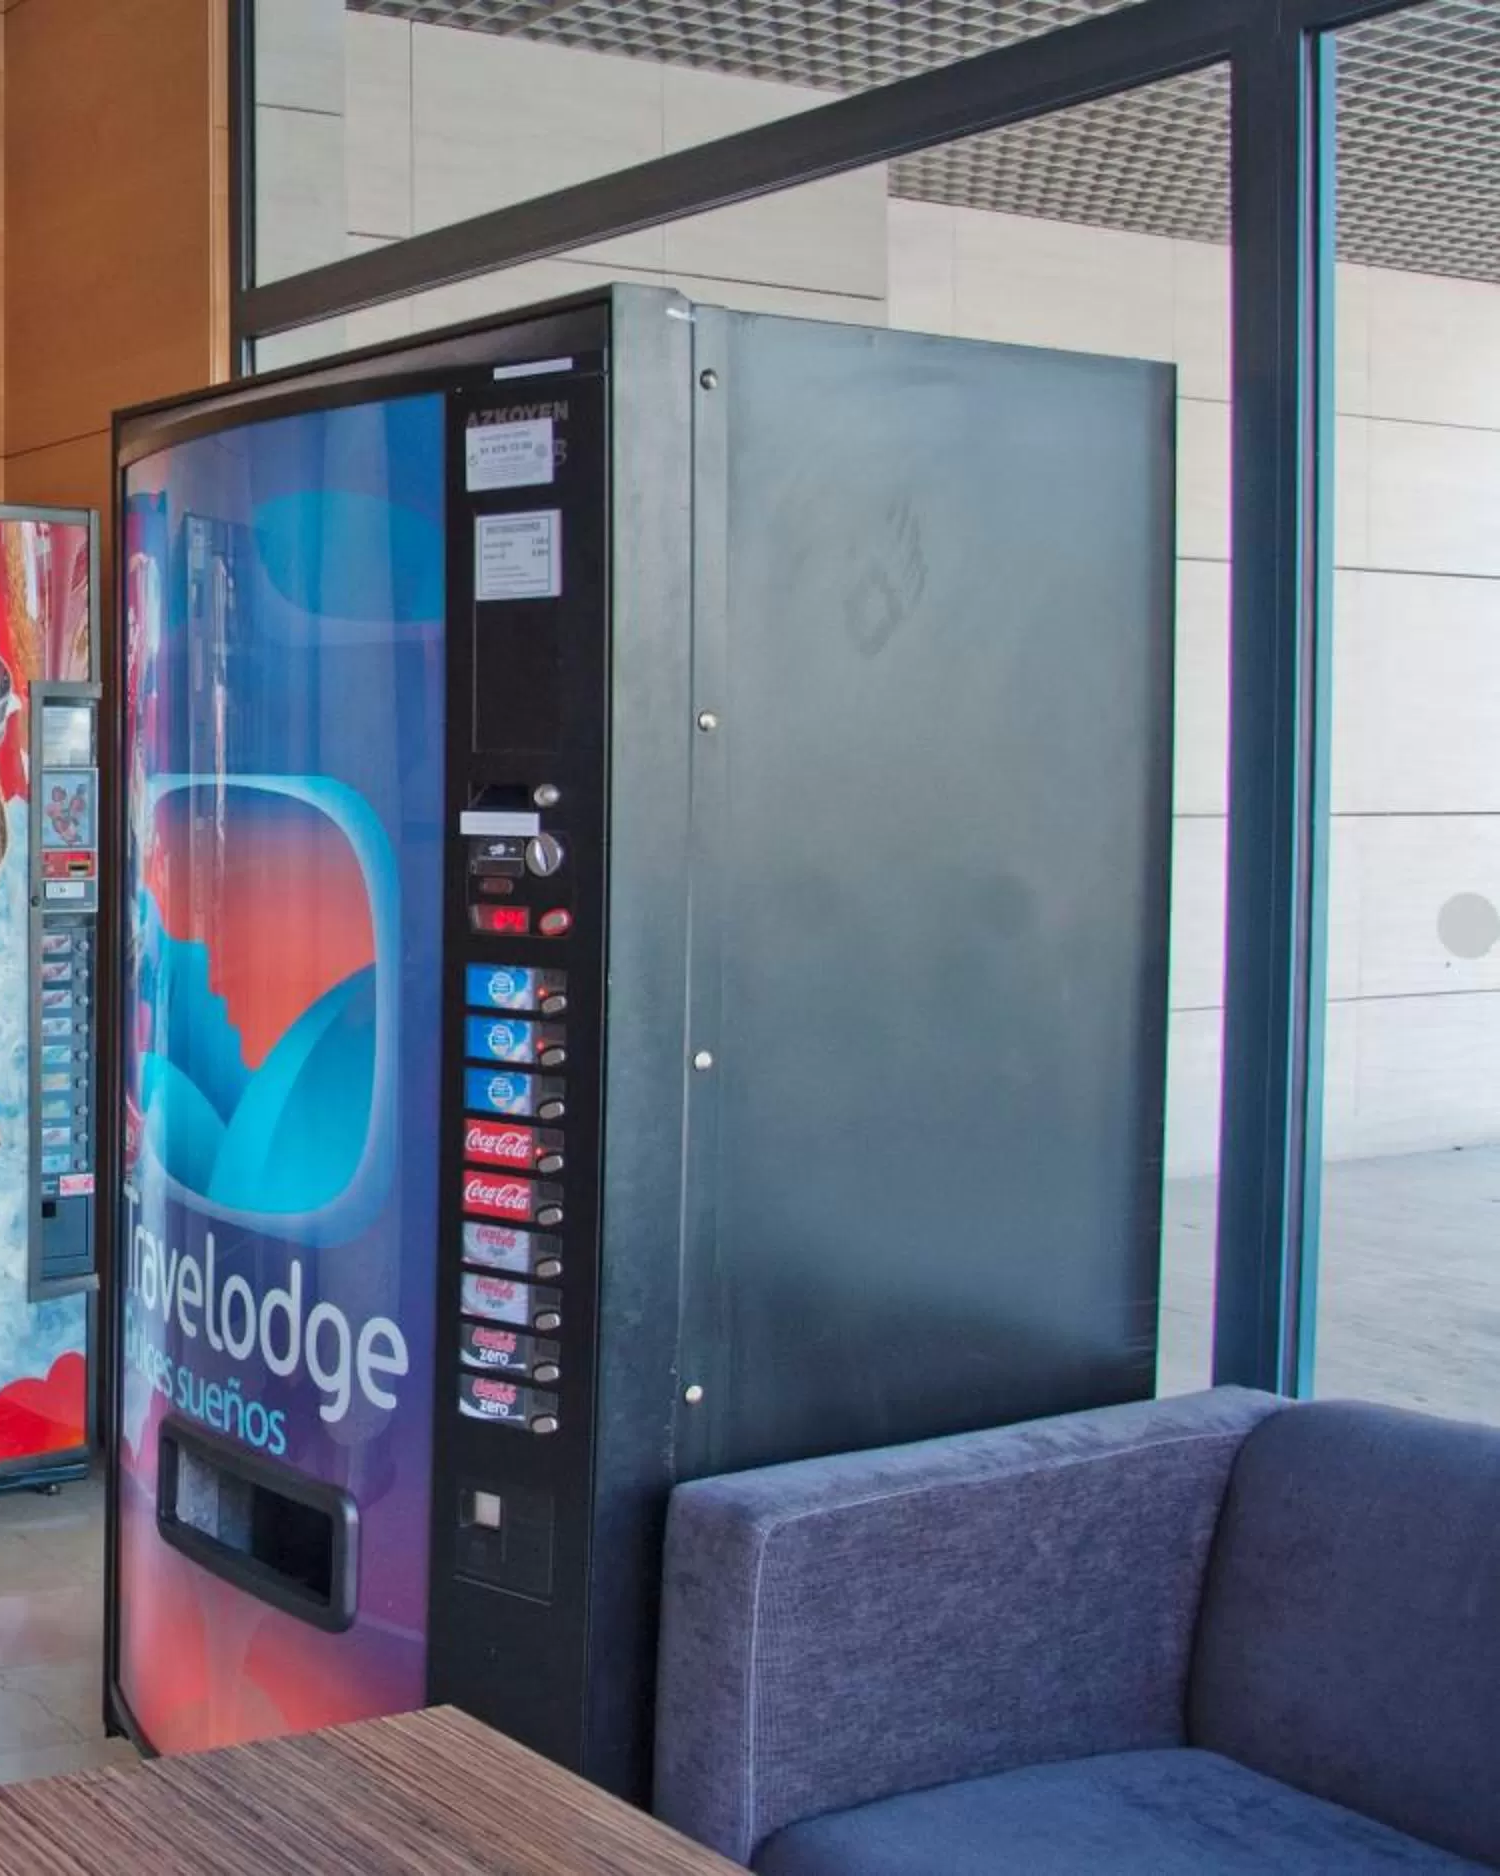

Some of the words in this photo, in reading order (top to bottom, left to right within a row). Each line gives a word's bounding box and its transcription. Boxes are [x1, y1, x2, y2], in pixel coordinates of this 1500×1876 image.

[467, 400, 569, 427] AZKOYEN
[479, 1348, 509, 1366] zero
[174, 1365, 288, 1456] sueños
[479, 1399, 509, 1417] zero
